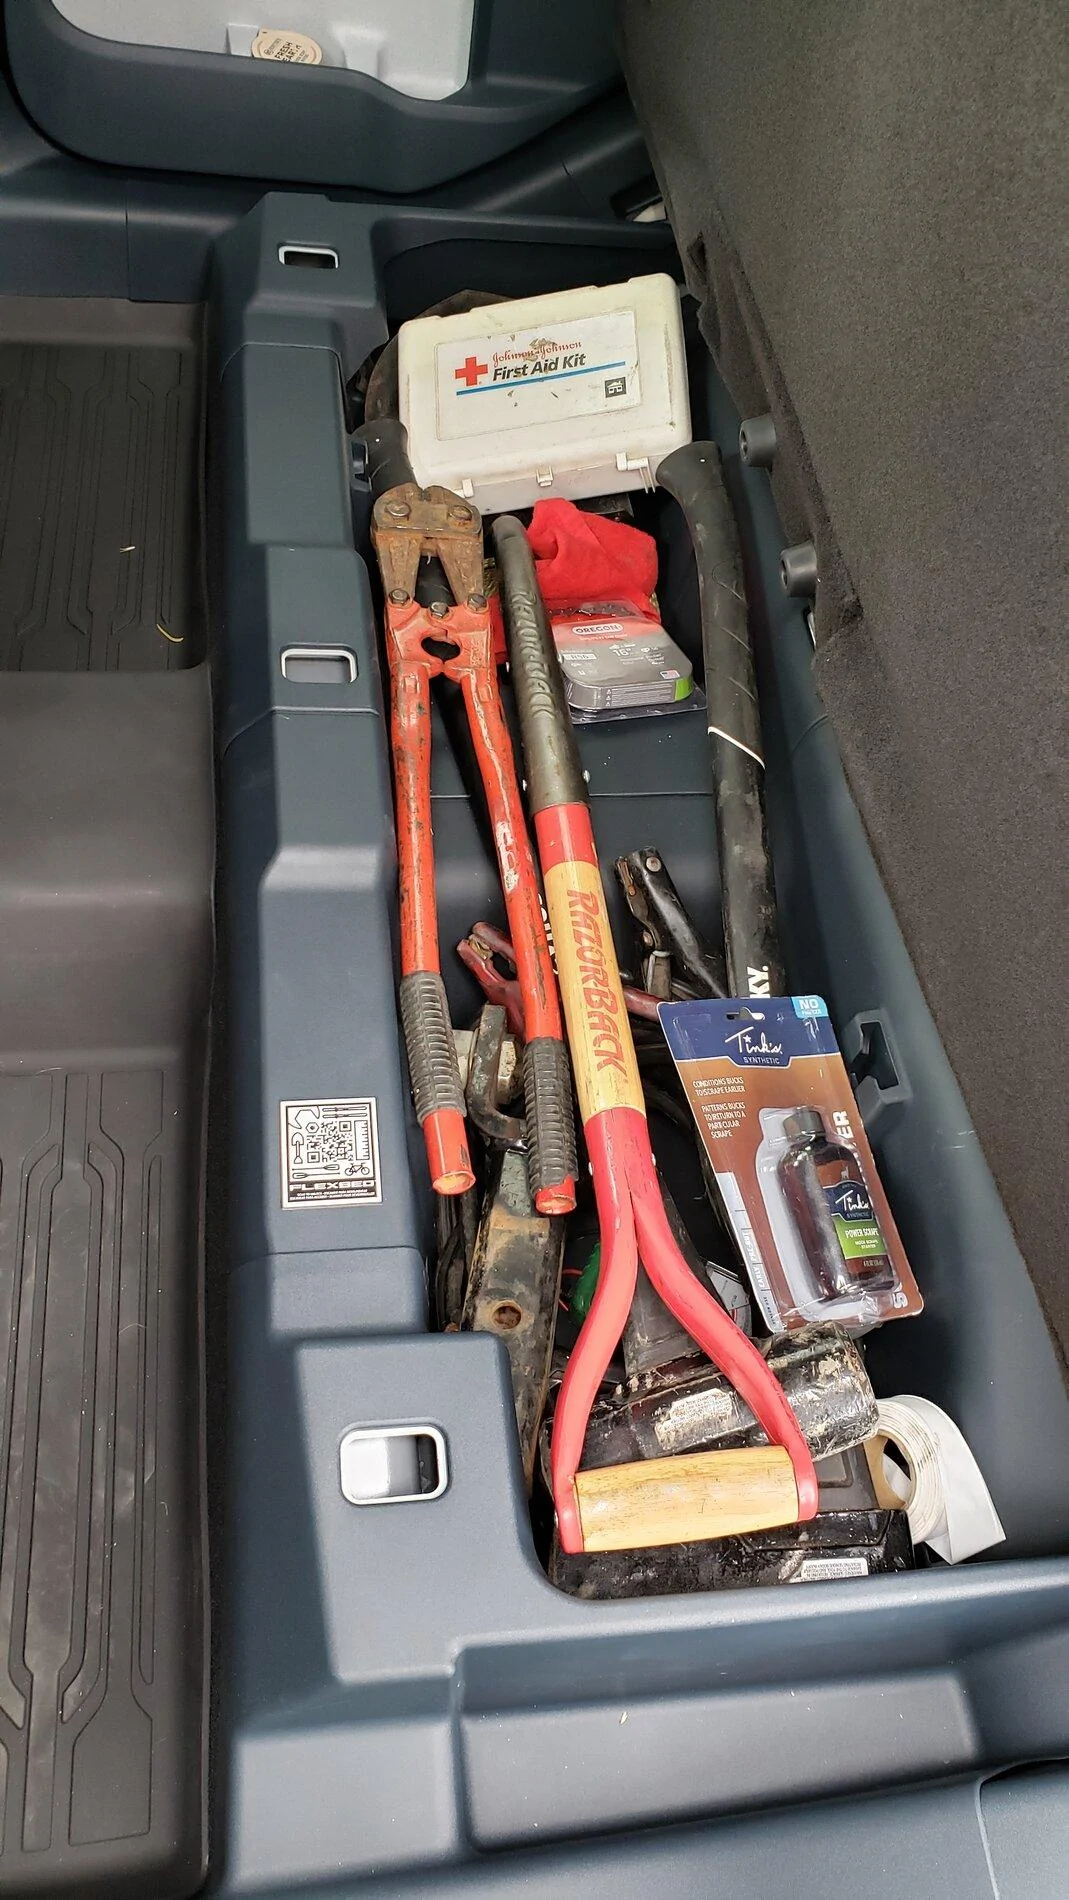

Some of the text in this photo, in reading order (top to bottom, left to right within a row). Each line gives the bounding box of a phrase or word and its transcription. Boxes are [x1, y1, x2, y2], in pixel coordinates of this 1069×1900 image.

[492, 353, 587, 381] First Aid Kit
[576, 624, 618, 634] OREGON
[566, 889, 628, 1077] RAZORBACK
[799, 998, 819, 1010] NO
[743, 1056, 780, 1065] SYNTHETIC
[692, 1076, 744, 1088] CONDITIONS BUCKS
[695, 1085, 746, 1097] TO SCRAPE EARLIER
[701, 1102, 746, 1112] PATTERNS BUCKS
[704, 1113, 712, 1121] TO
[712, 1111, 734, 1120] RETURN
[741, 1110, 747, 1118] A
[711, 1130, 733, 1139] SCRAPE
[289, 1179, 375, 1192] FLEXBED
[844, 1227, 880, 1239] POWER SCRAPE
